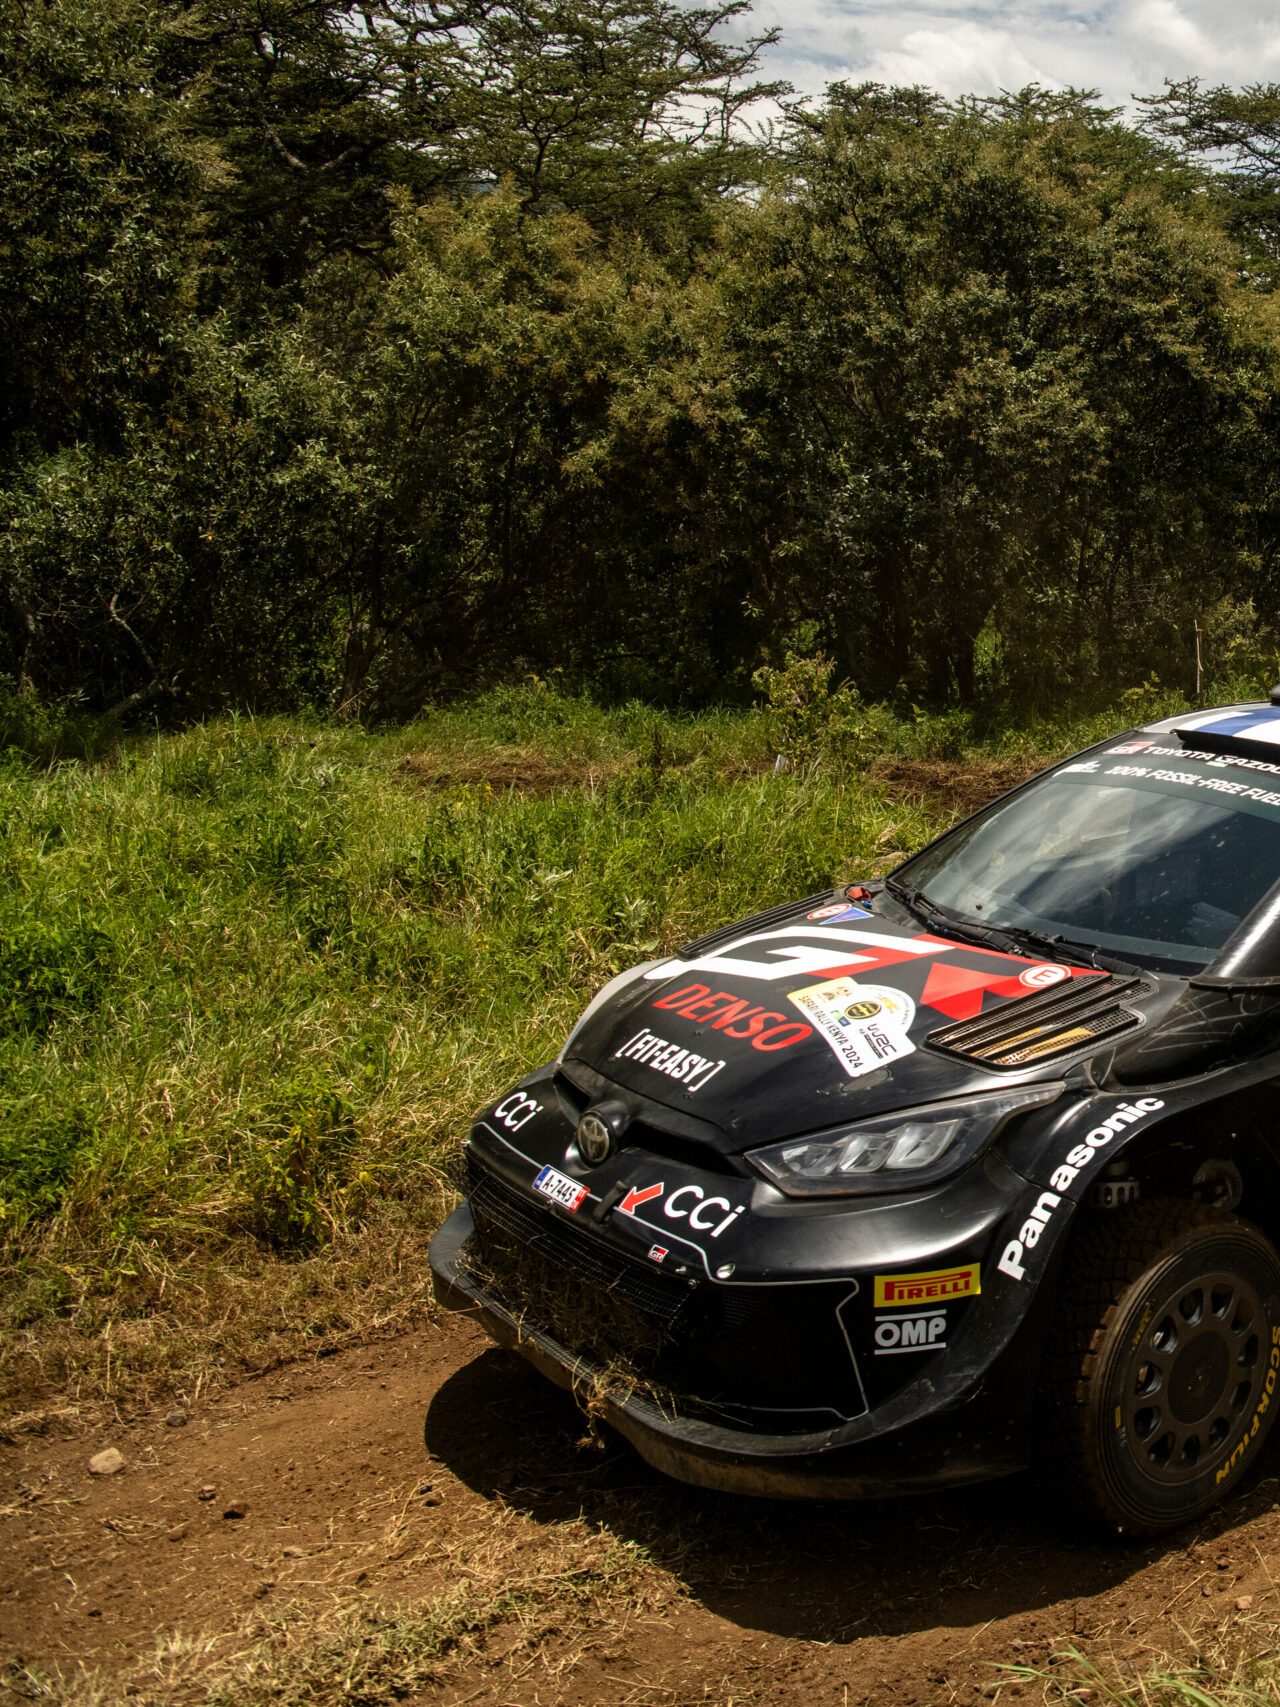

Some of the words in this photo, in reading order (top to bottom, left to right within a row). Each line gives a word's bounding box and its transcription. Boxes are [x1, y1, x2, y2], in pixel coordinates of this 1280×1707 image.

[1142, 747, 1215, 761] TOYOTA
[1104, 766, 1152, 777] 100%
[1145, 769, 1249, 796] FOSSIL-FREE
[651, 983, 813, 1051] DENSO
[798, 995, 820, 1014] SAFARI
[813, 1010, 830, 1026] RALLY
[826, 1023, 848, 1046] KENYA
[842, 1045, 864, 1069] 2024
[867, 1023, 897, 1057] WRC
[542, 1175, 577, 1202] A-7445
[997, 1097, 1165, 1281] Panasonic
[884, 1270, 973, 1301] PIRELLI
[874, 1316, 947, 1348] OMP
